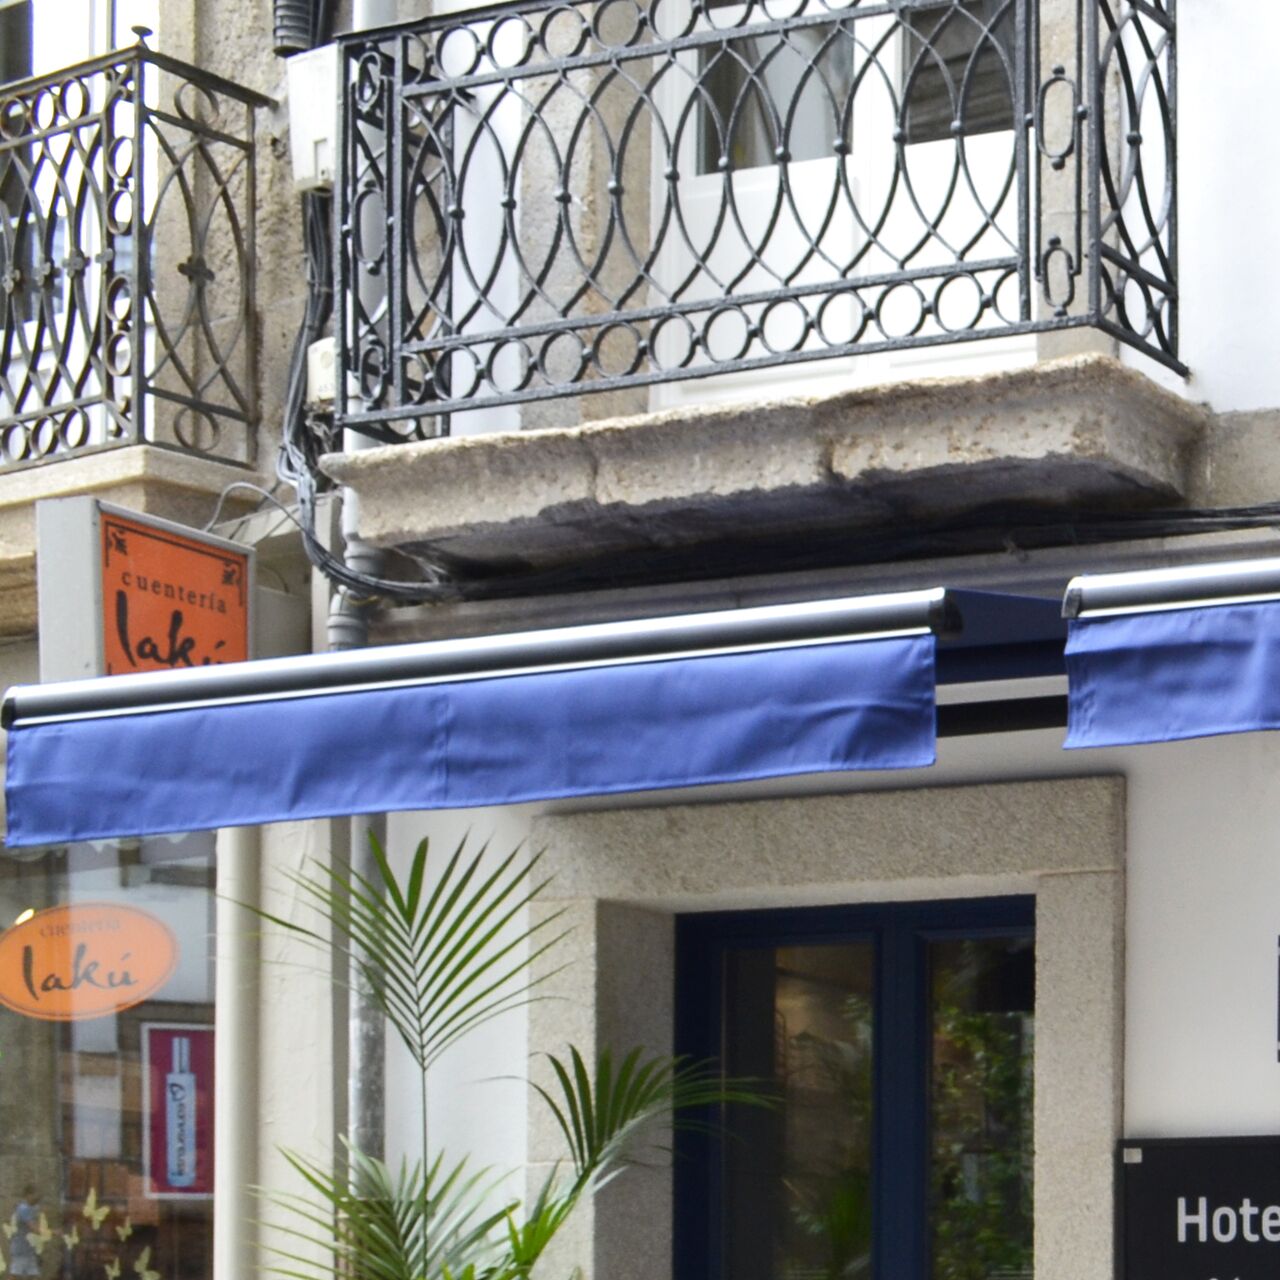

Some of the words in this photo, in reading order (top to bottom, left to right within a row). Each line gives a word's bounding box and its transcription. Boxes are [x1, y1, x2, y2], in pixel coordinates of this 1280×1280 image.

[121, 571, 227, 614] cuentería
[116, 588, 227, 668] lak
[22, 942, 139, 1001] lakú
